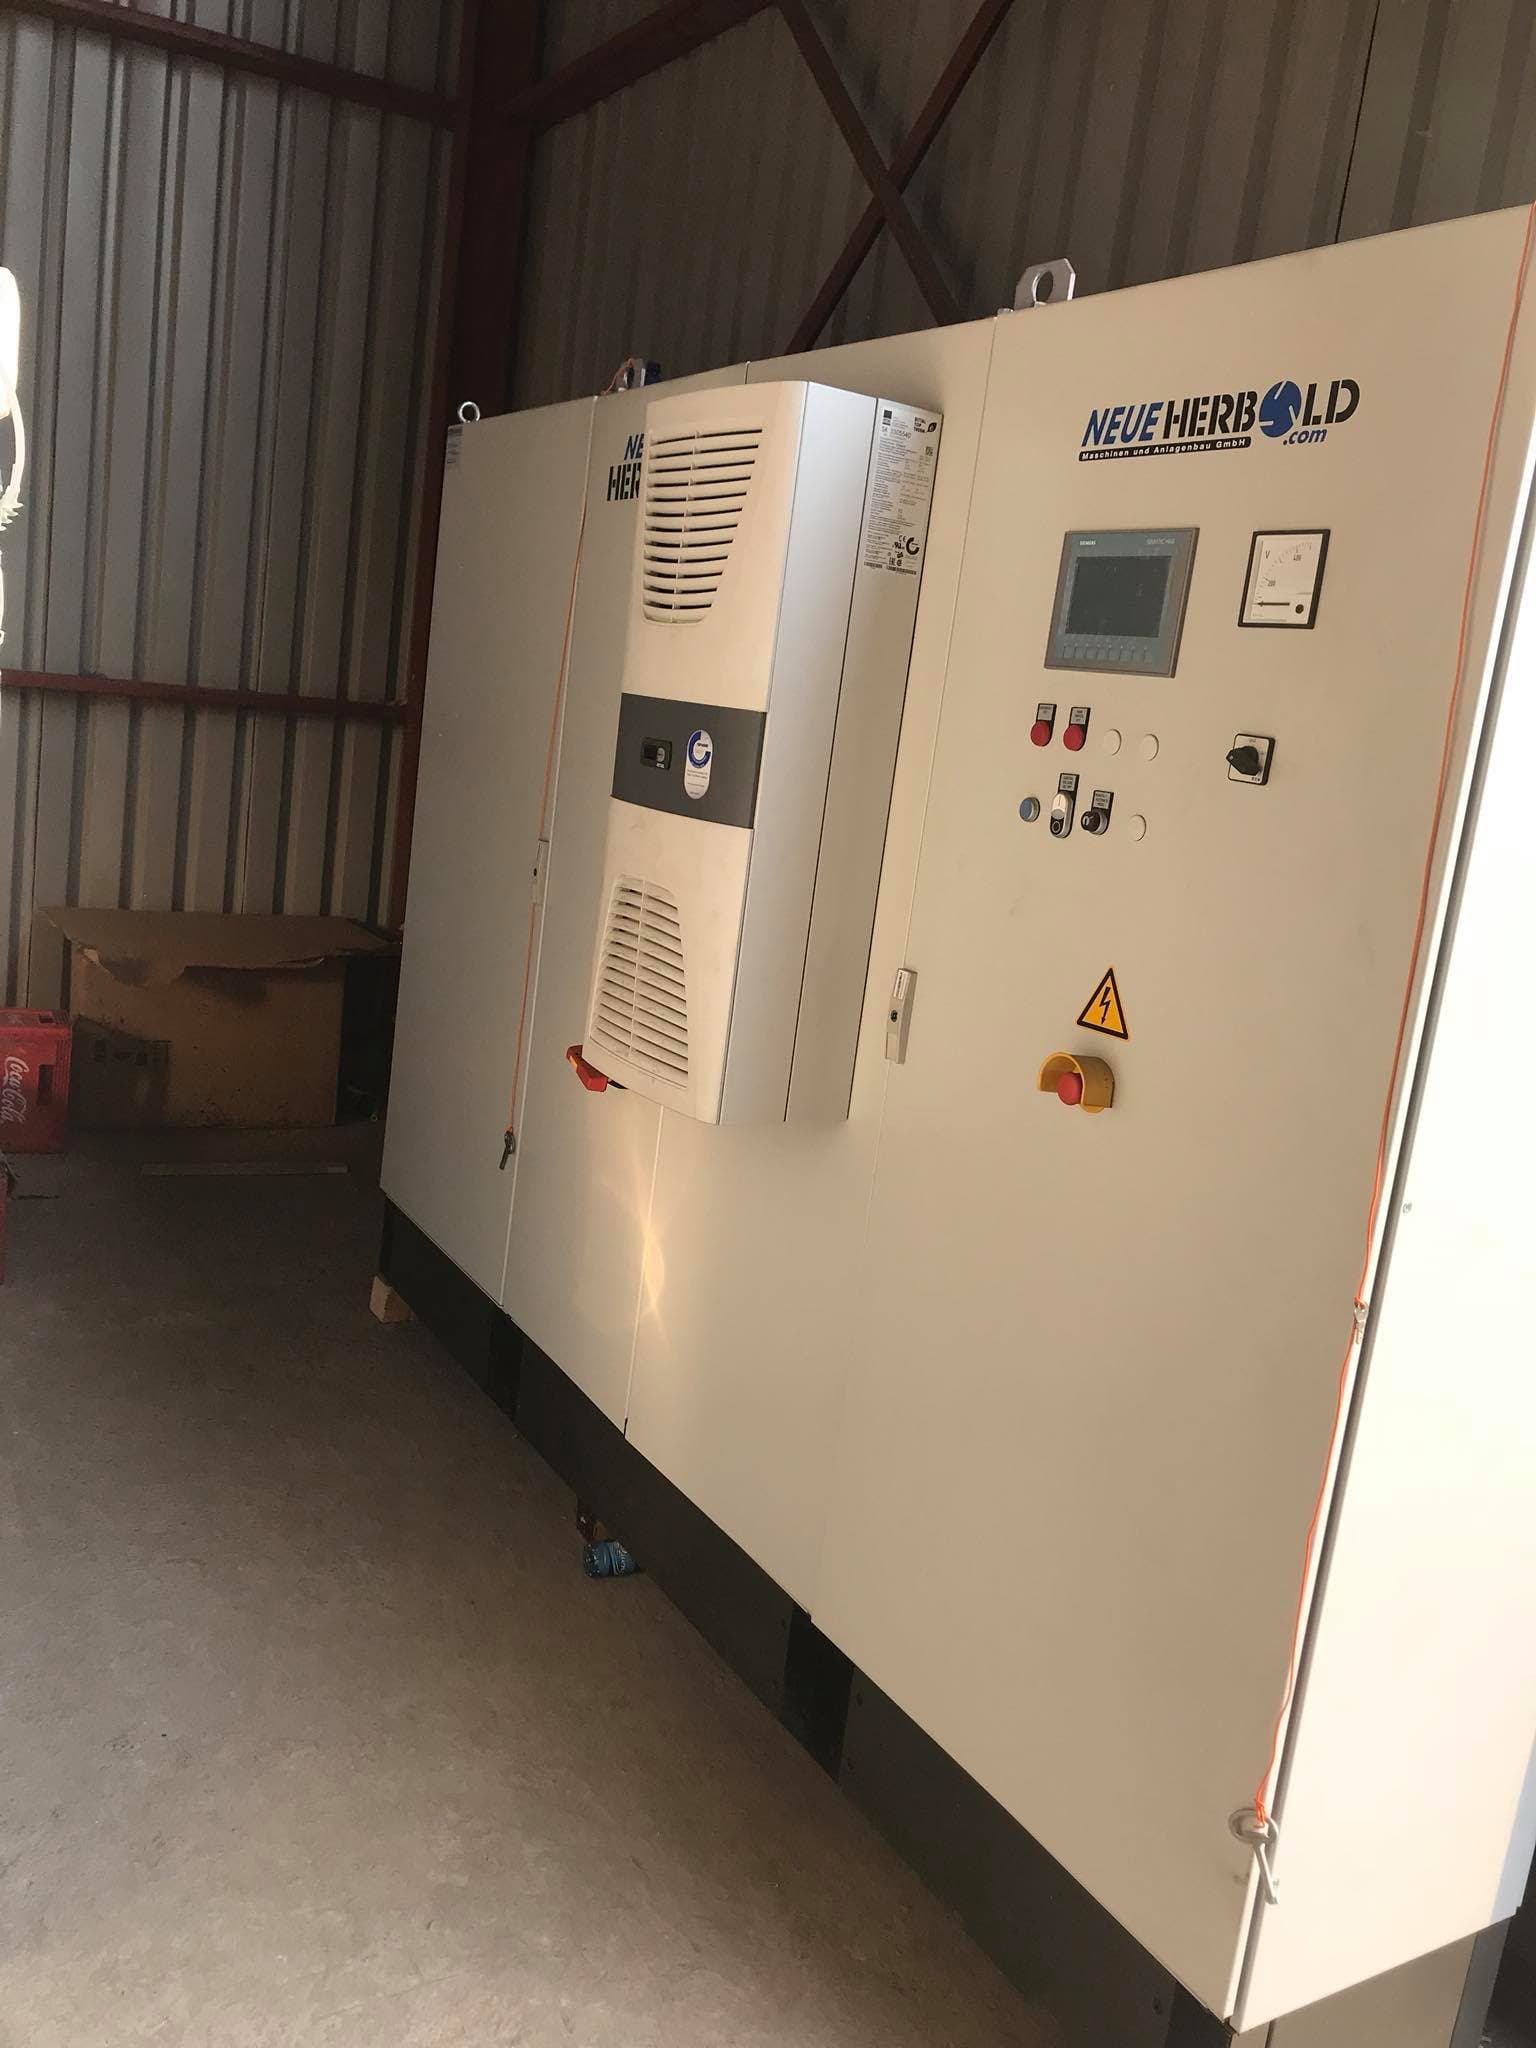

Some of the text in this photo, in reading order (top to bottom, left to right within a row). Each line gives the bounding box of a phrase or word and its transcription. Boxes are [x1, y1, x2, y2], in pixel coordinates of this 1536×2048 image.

[1081, 438, 1246, 460] Maschinen und Anlagenbau GmbH
